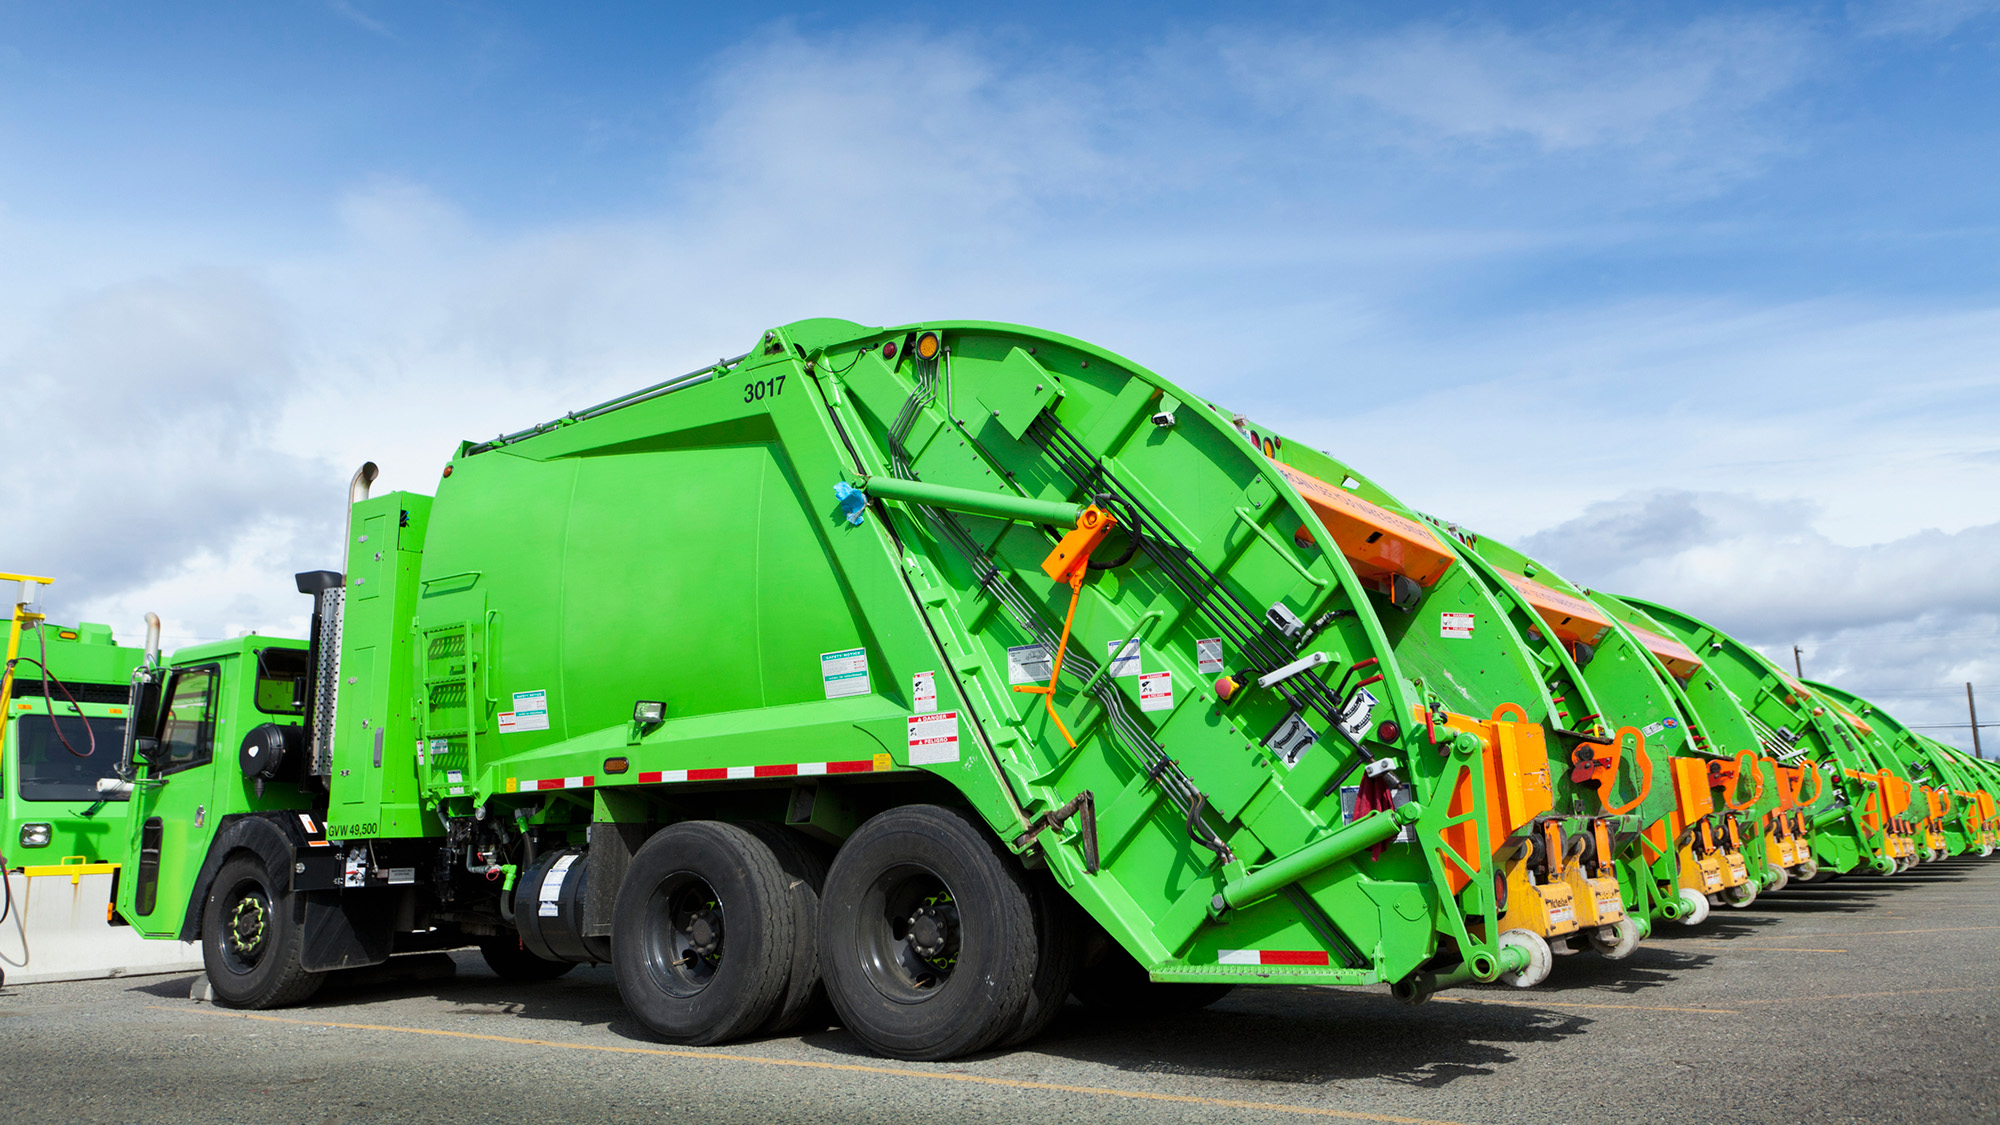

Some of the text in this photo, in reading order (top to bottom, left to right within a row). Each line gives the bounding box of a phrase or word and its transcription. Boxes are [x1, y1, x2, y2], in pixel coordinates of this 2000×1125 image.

[744, 375, 786, 403] 3017
[925, 737, 948, 745] PELIGRO
[329, 823, 377, 837] GVW 49,500
